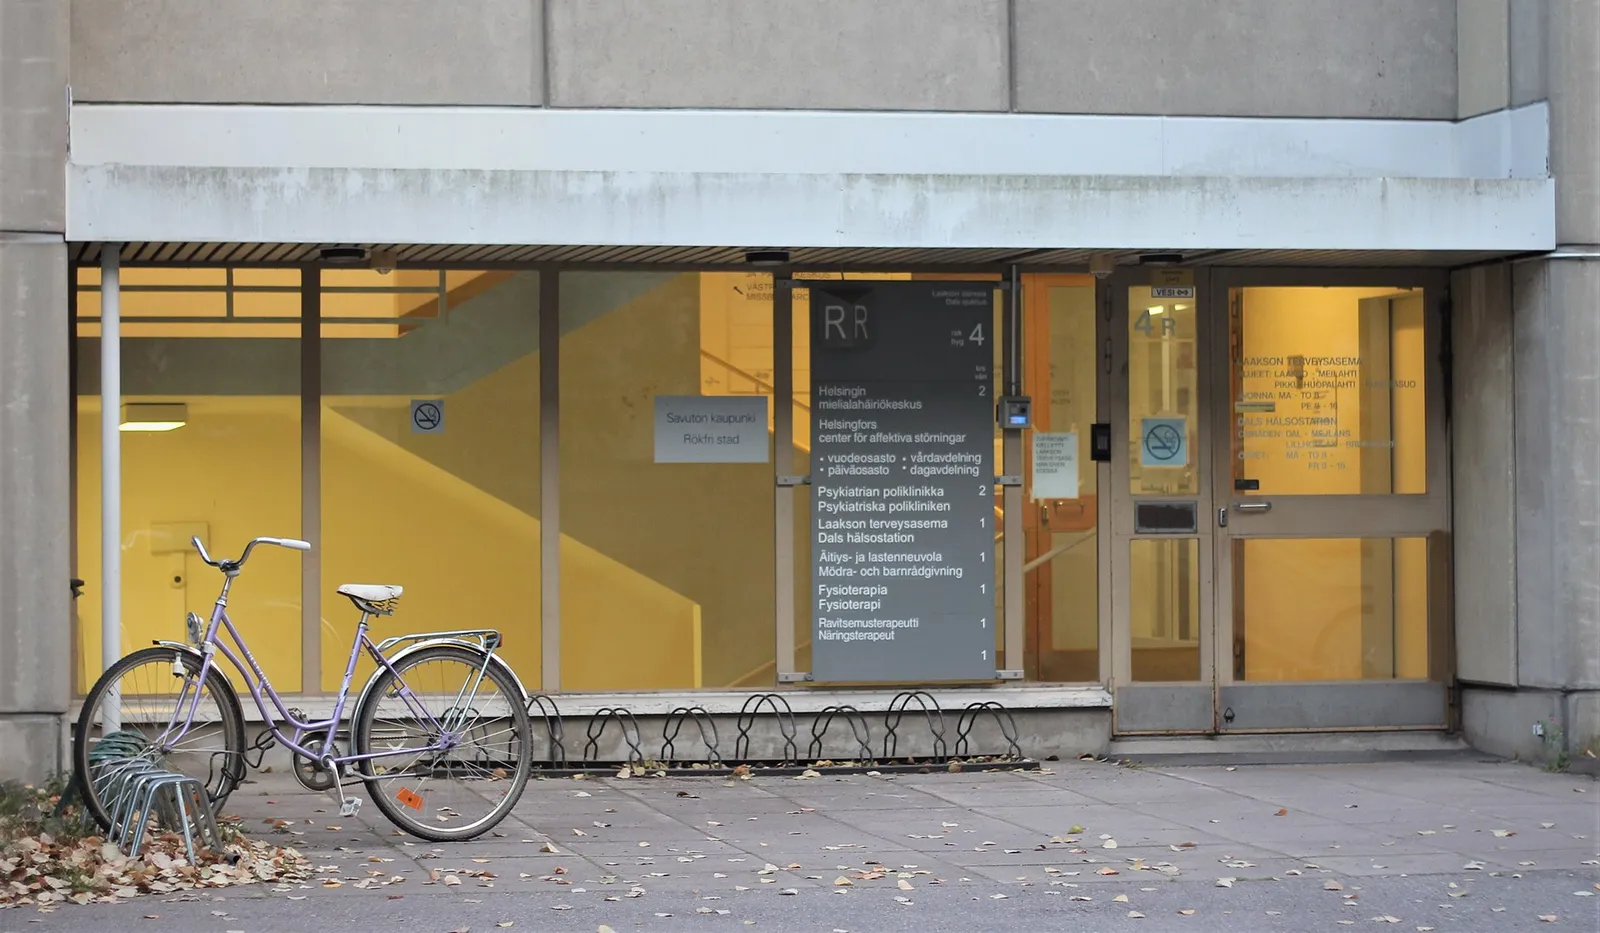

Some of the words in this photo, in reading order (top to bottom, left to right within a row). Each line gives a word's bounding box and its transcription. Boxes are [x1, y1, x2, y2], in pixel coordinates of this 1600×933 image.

[825, 305, 846, 339] R
[854, 305, 868, 339] R
[1162, 318, 1176, 336] R
[969, 323, 984, 345] 4
[1287, 356, 1363, 366] TERVEYSASEMA
[819, 386, 866, 397] Helsingin
[978, 386, 986, 396] 2
[1301, 391, 1311, 399] TO
[819, 400, 922, 410] mielialahäiriökeskus
[666, 412, 708, 424] Savuton
[710, 412, 756, 426] kaupunki
[819, 419, 877, 432] Helsingfors
[683, 433, 714, 445] Rökfri
[716, 434, 740, 445] stad
[819, 434, 851, 443] center
[854, 433, 867, 443] för
[869, 433, 912, 443] affektiva
[914, 433, 966, 445] störningar
[828, 454, 896, 463] vuodeosasto
[910, 452, 982, 464] vårdavdelning
[828, 466, 889, 476] päiväosasto
[910, 465, 979, 476] dagavdelning
[818, 486, 880, 498] Psykiatrian
[883, 486, 944, 498] poliklinikka
[979, 486, 986, 496] 2
[818, 501, 886, 513] Psykiatriska
[889, 501, 951, 513] polikliniken
[818, 519, 866, 529] Laakson
[869, 520, 948, 531] terveysasema
[979, 518, 985, 528] 1
[818, 533, 844, 543] Dals
[847, 533, 914, 543] hälsostation
[819, 550, 852, 563] Äitiys-
[855, 553, 865, 564] ja
[868, 552, 942, 562] lastenneuvola
[979, 552, 985, 562] 1
[818, 566, 857, 576] Mödra-
[860, 567, 880, 576] och
[883, 566, 963, 578] barnrådgivning
[818, 585, 888, 597] Fysioterapia
[979, 584, 986, 594] 1
[819, 600, 881, 612] Fysioterapi
[819, 618, 919, 628] Ravitsemusterapeutti
[980, 618, 986, 628] 1
[819, 630, 895, 642] Näringsterapeut
[981, 650, 987, 660] 1
